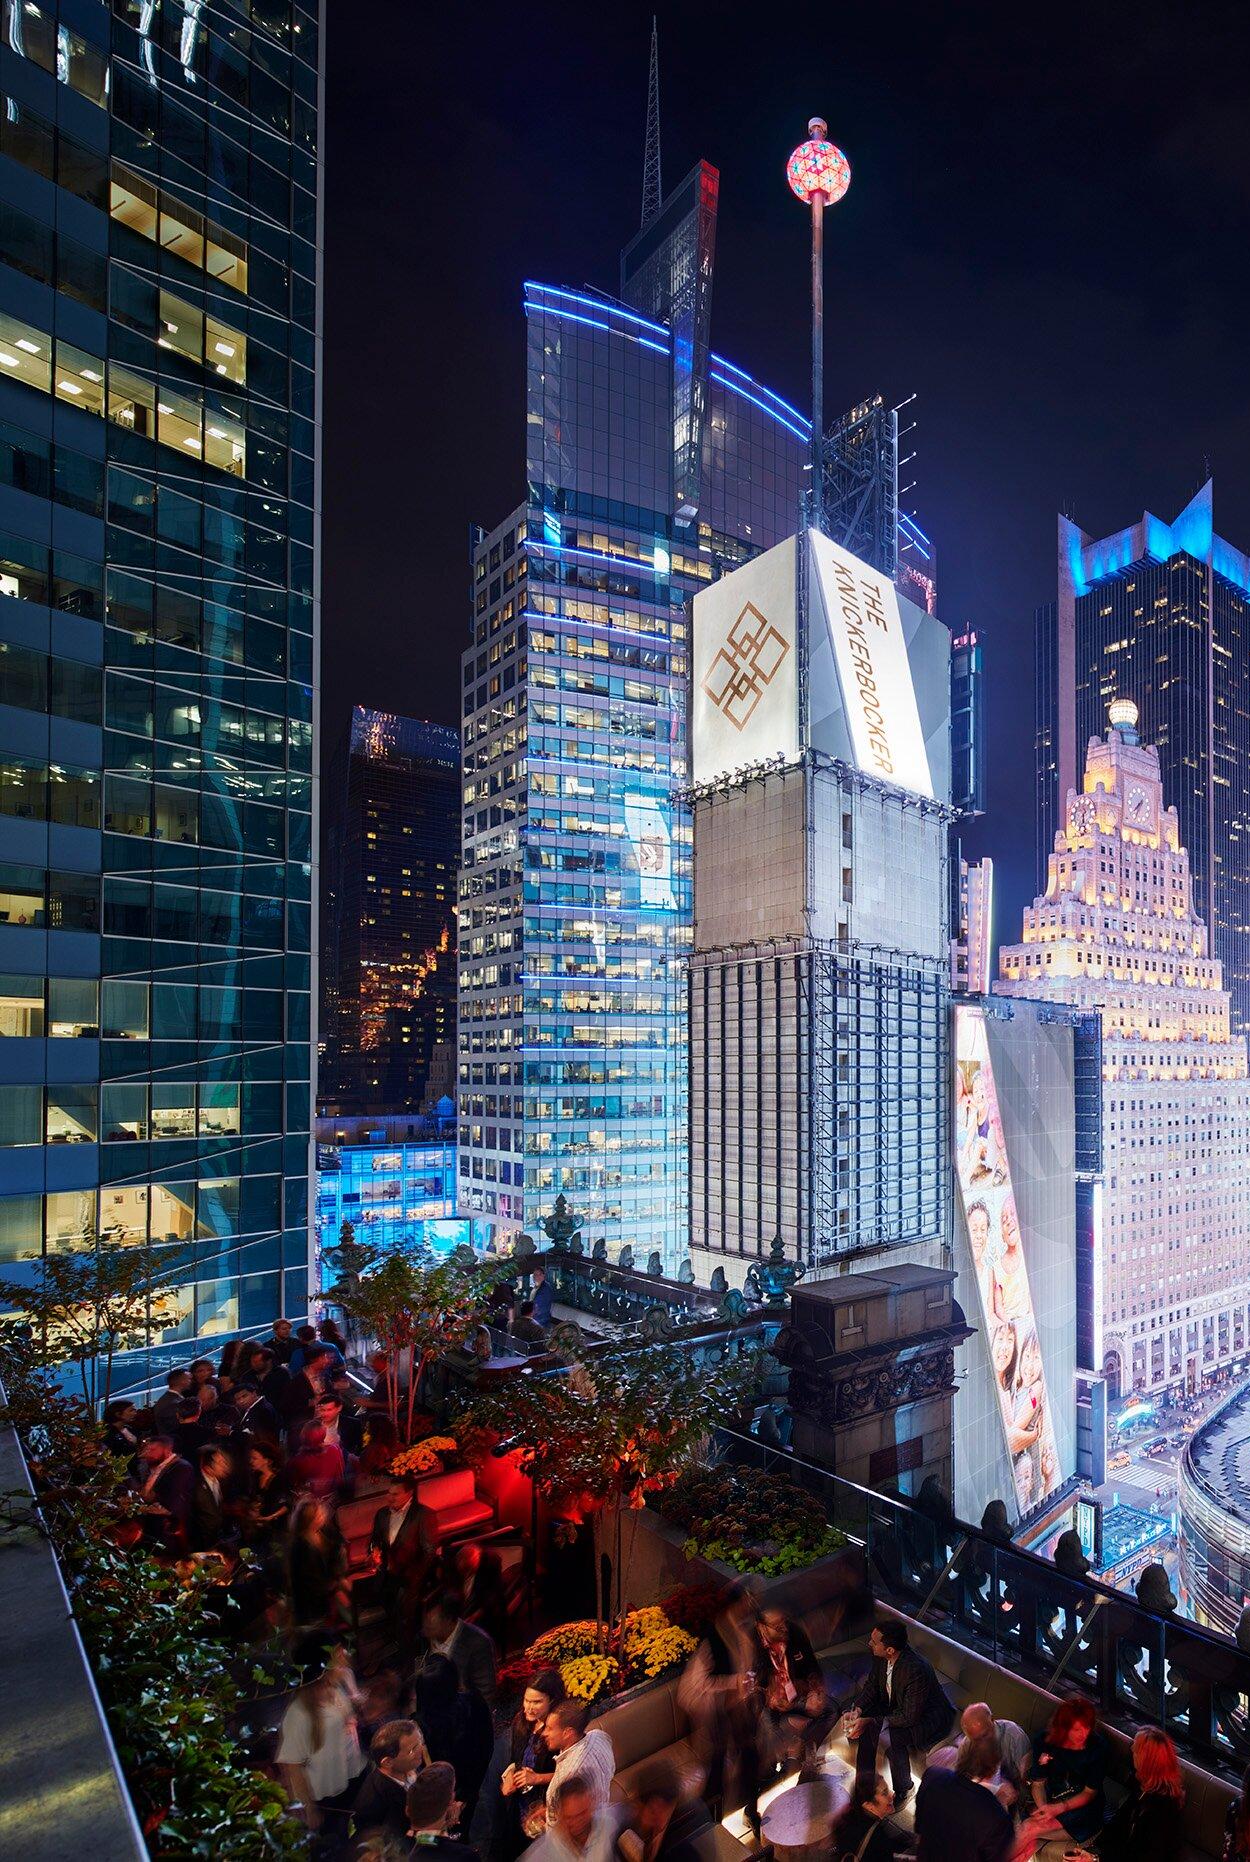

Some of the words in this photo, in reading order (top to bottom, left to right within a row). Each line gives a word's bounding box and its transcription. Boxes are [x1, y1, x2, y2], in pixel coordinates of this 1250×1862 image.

[861, 580, 888, 632] THE
[832, 560, 893, 775] KNICKERBOCKER
[1122, 1557, 1143, 1577] NYPD
